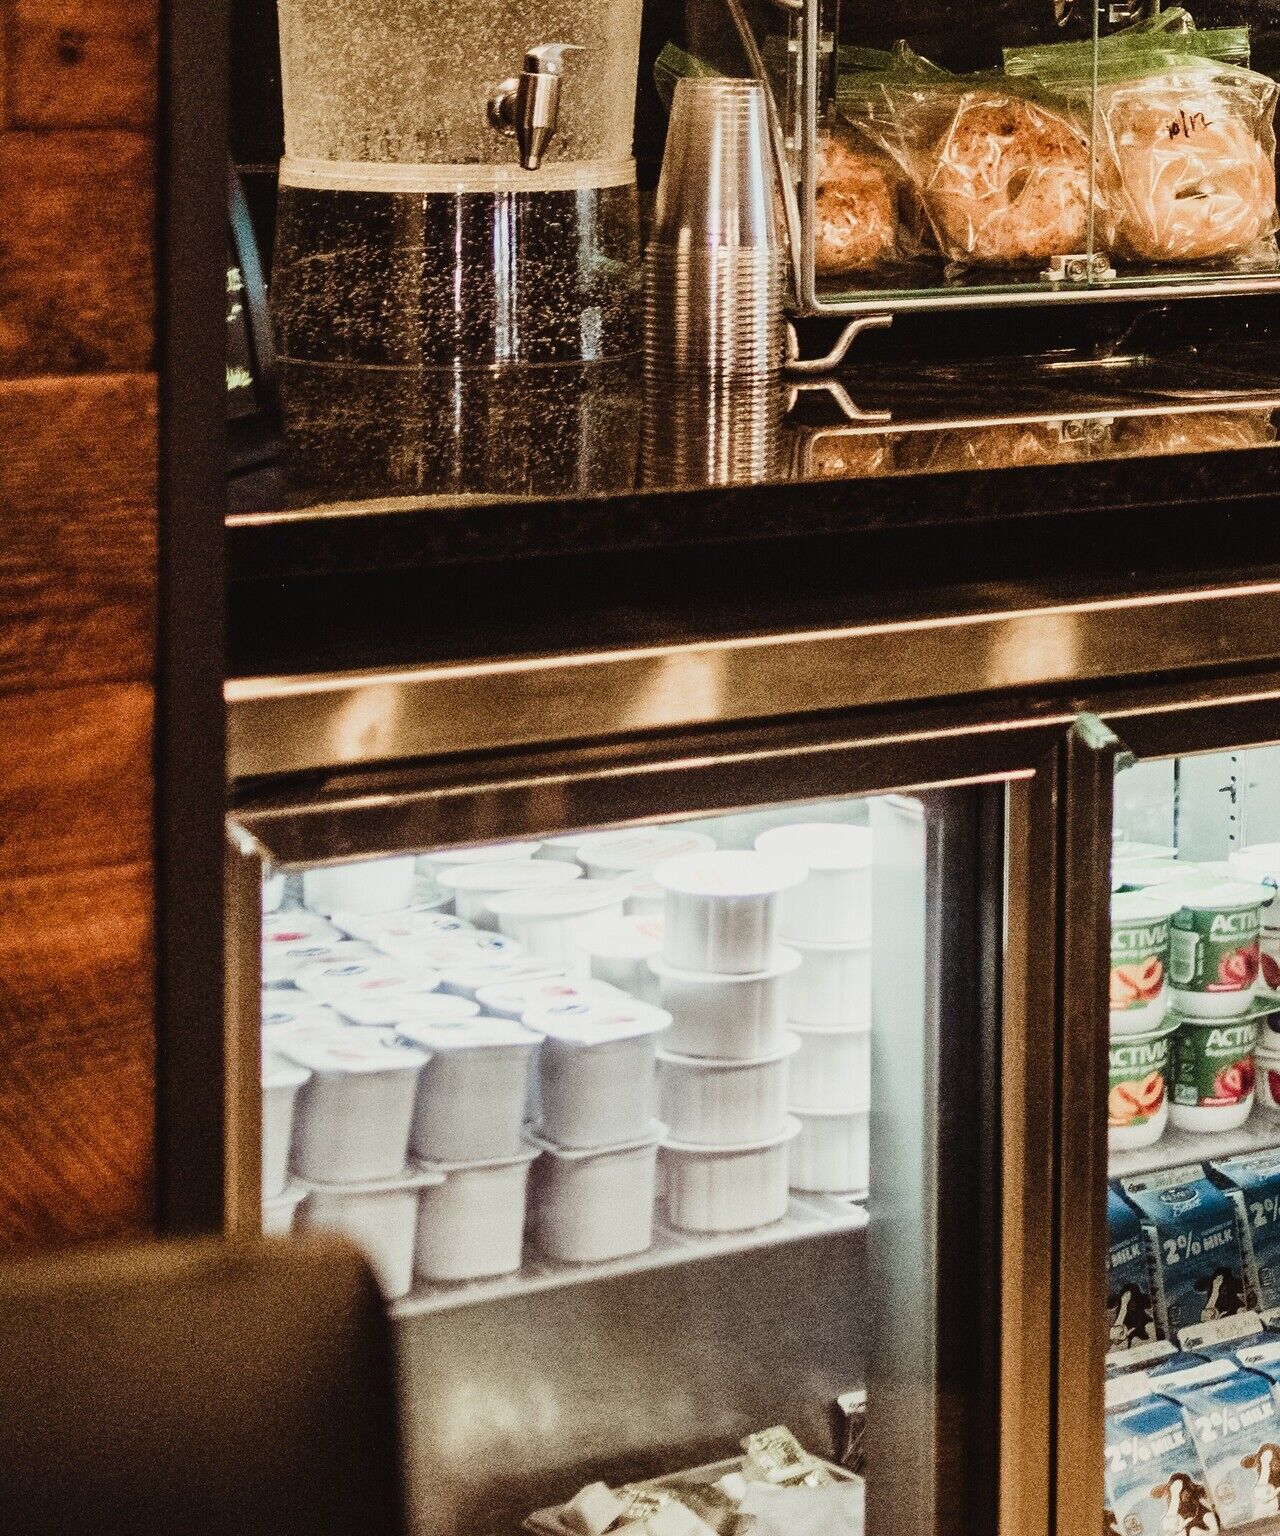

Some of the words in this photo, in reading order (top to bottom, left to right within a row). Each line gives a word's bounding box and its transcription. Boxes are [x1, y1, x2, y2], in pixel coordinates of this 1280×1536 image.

[1111, 1242, 1142, 1266] MILK
[1163, 1230, 1201, 1265] 2%
[1203, 1228, 1233, 1252] MILK
